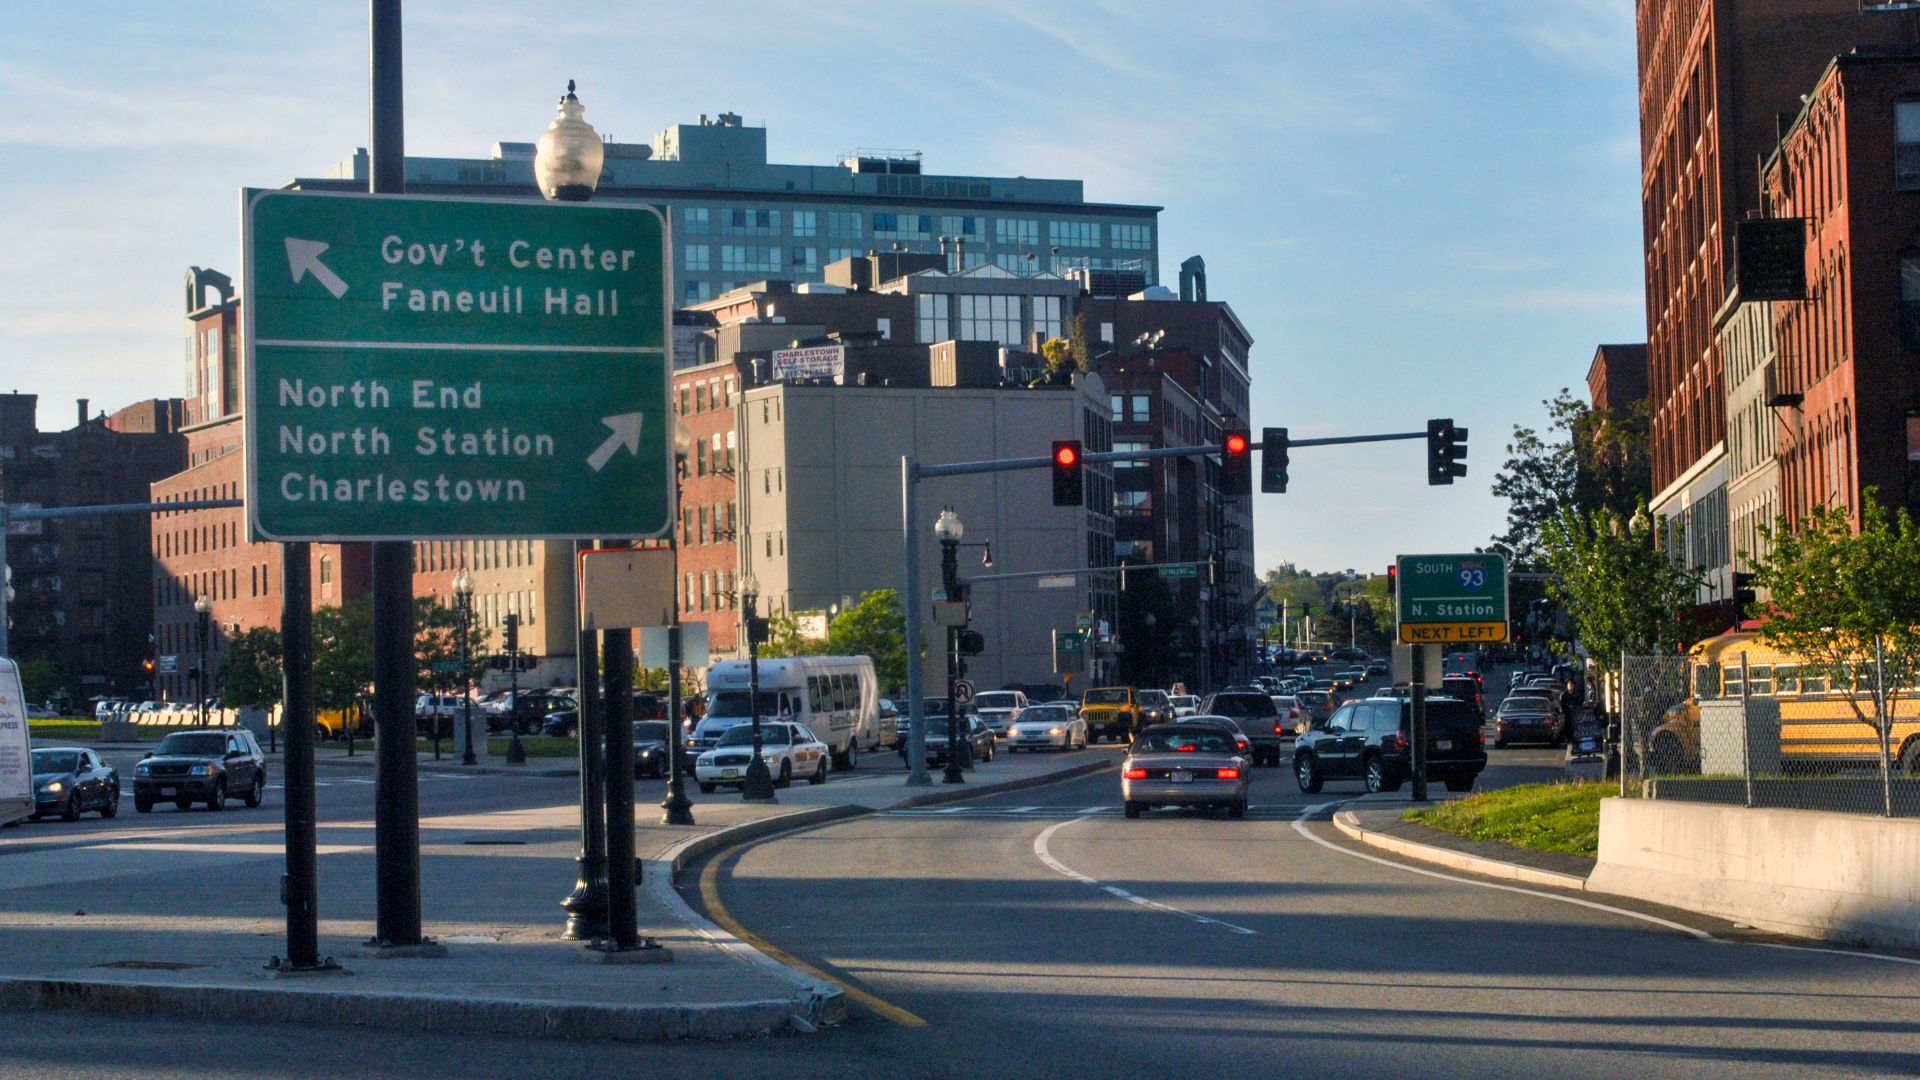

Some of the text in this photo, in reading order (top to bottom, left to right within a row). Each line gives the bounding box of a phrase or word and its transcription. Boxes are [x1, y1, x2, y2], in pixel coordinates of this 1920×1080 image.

[381, 235, 636, 271] Gov't Center
[381, 281, 618, 316] Faneuil Hall
[777, 348, 840, 359] CHARLESTOWN
[777, 355, 839, 366] SELF-STORAGE
[279, 378, 482, 409] North End
[279, 425, 554, 456] North Station
[280, 471, 525, 502] Charlestown
[1415, 563, 1453, 574] SOUTH
[1460, 570, 1484, 587] 93
[1412, 603, 1494, 616] N. Station
[1411, 626, 1495, 639] NEXT LEFT
